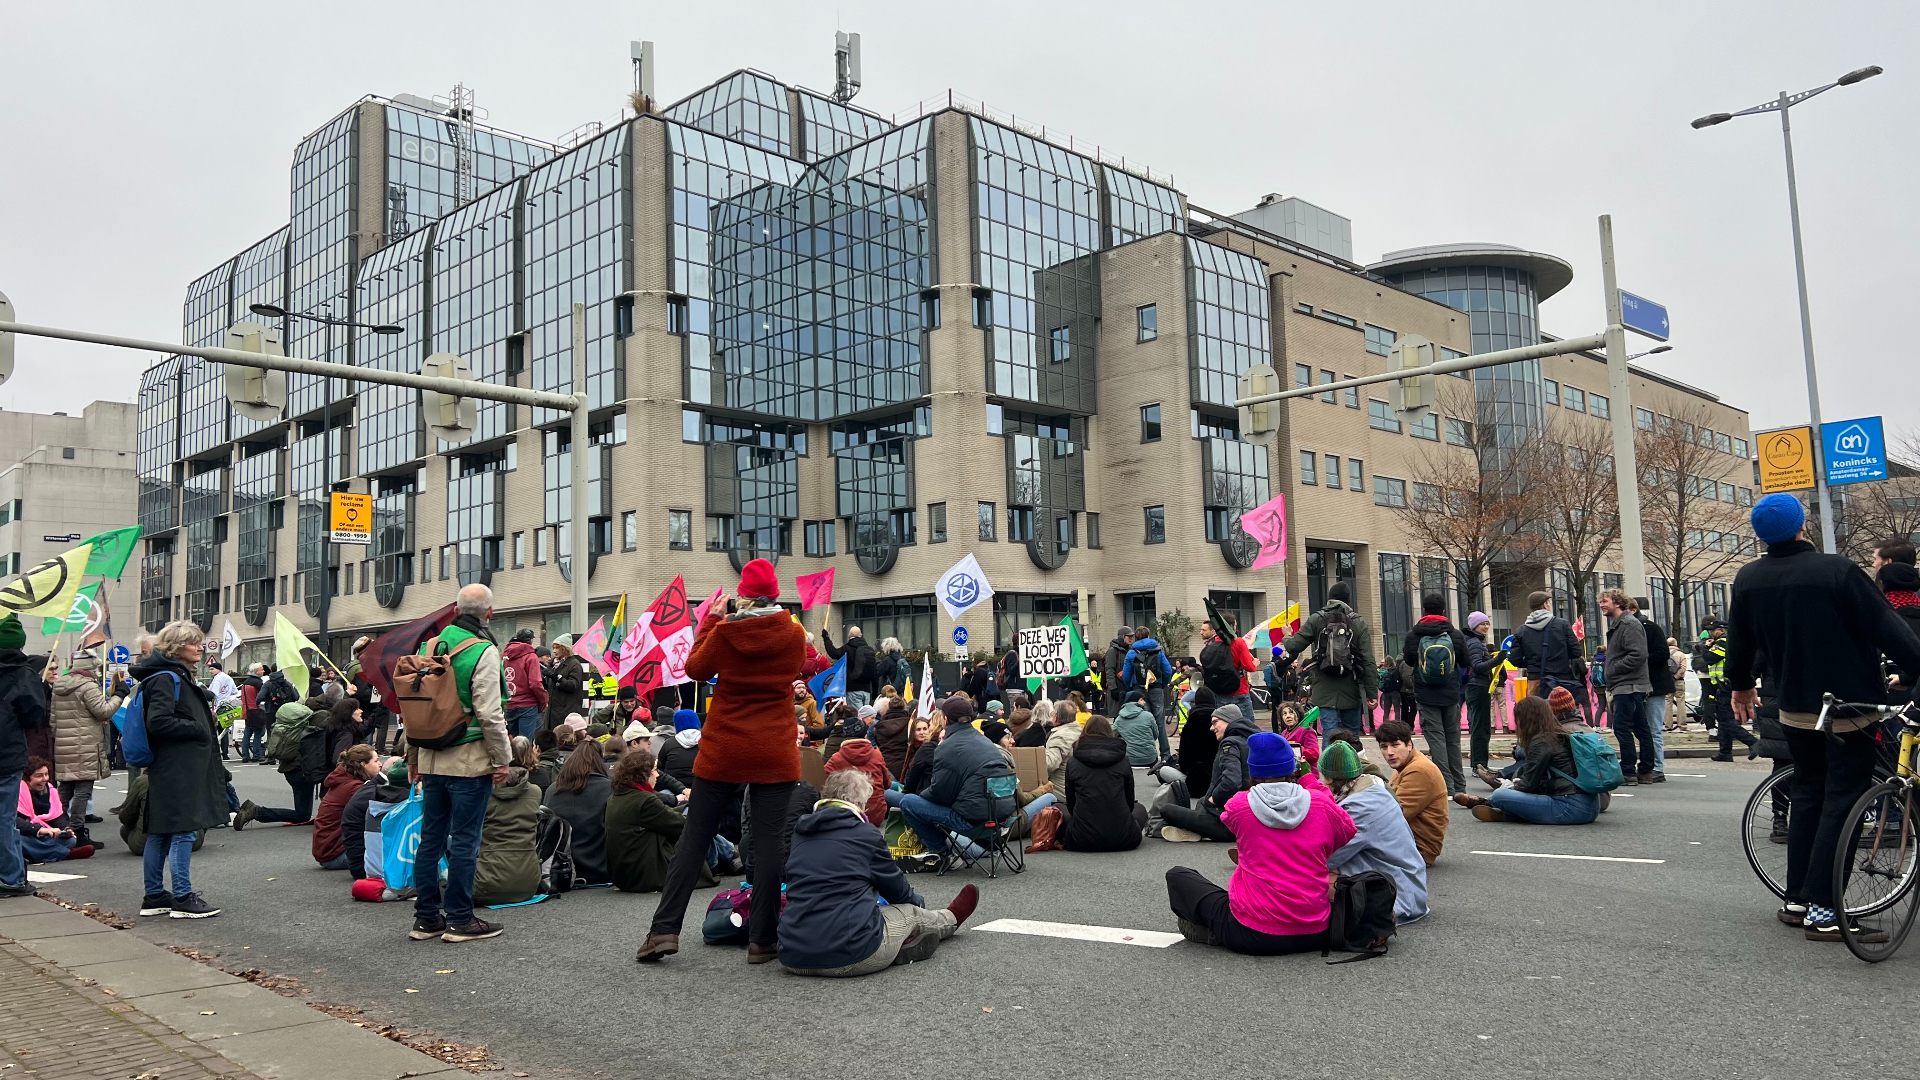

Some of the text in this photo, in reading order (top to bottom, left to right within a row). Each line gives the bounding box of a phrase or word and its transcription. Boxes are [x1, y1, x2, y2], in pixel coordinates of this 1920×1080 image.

[1832, 456, 1878, 468] Konincks
[1020, 627, 1066, 645] DEZE WEG
[1026, 643, 1062, 658] LOOPT
[1023, 658, 1064, 675] DOOD
